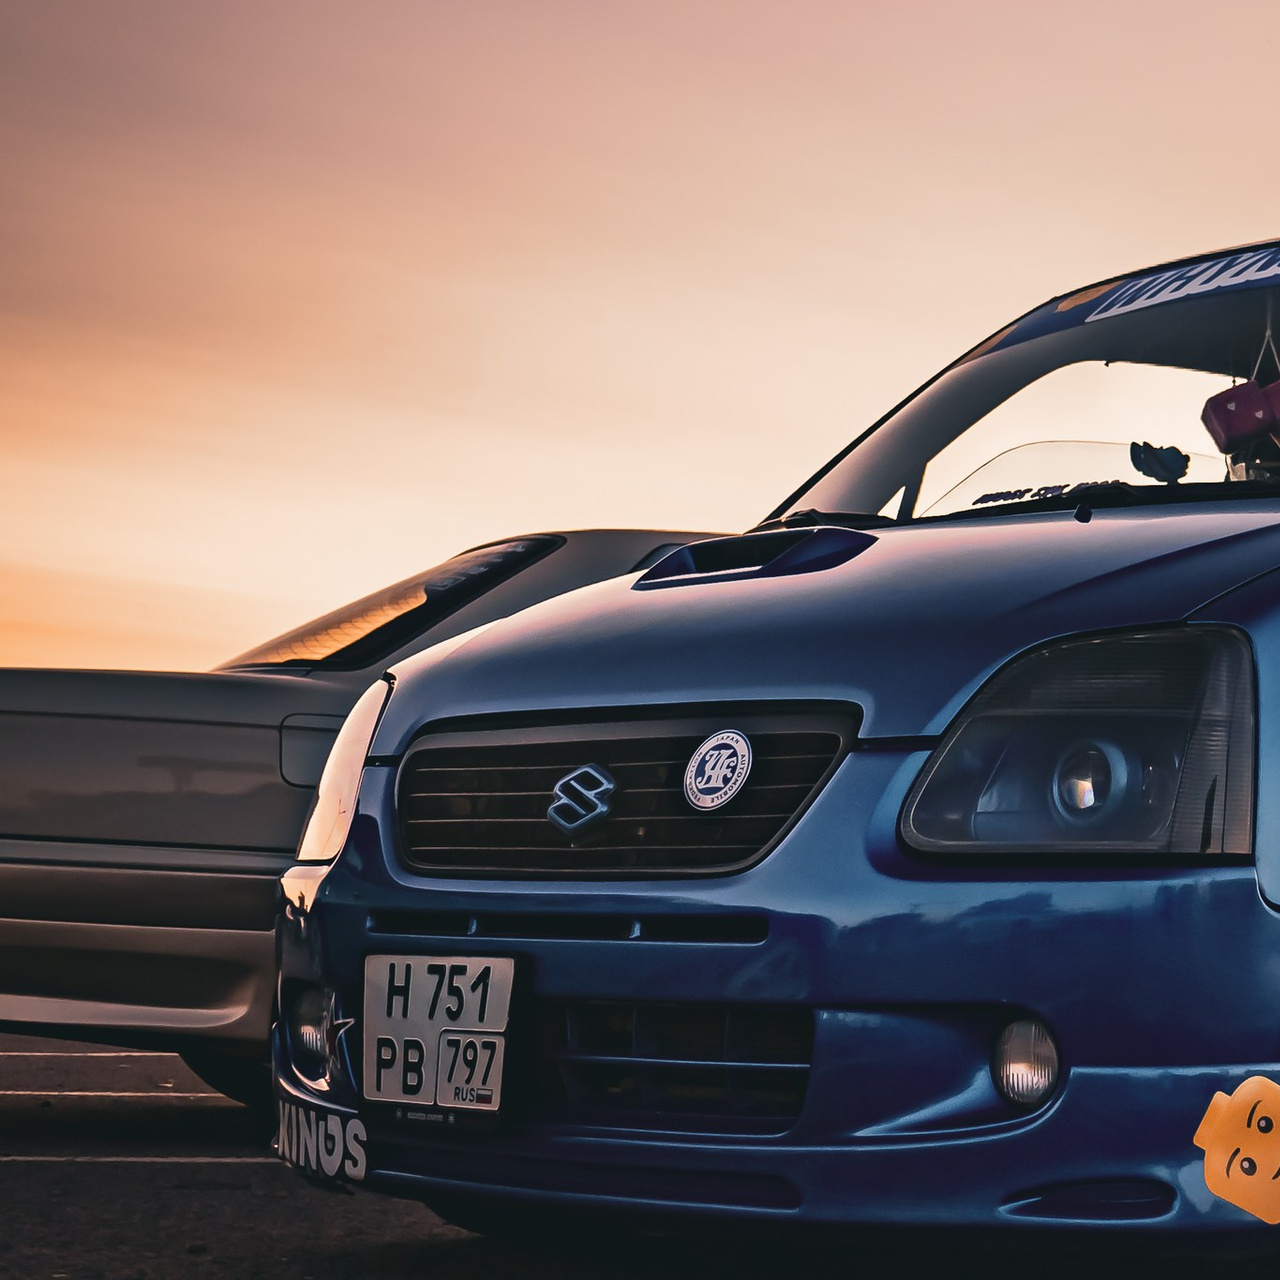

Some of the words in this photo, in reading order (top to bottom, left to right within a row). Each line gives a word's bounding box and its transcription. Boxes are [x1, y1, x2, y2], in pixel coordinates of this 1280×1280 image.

[386, 961, 412, 1019] H
[426, 963, 492, 1024] 751
[376, 1036, 425, 1096] PB
[446, 1037, 498, 1087] 797
[453, 1086, 476, 1103] RUS
